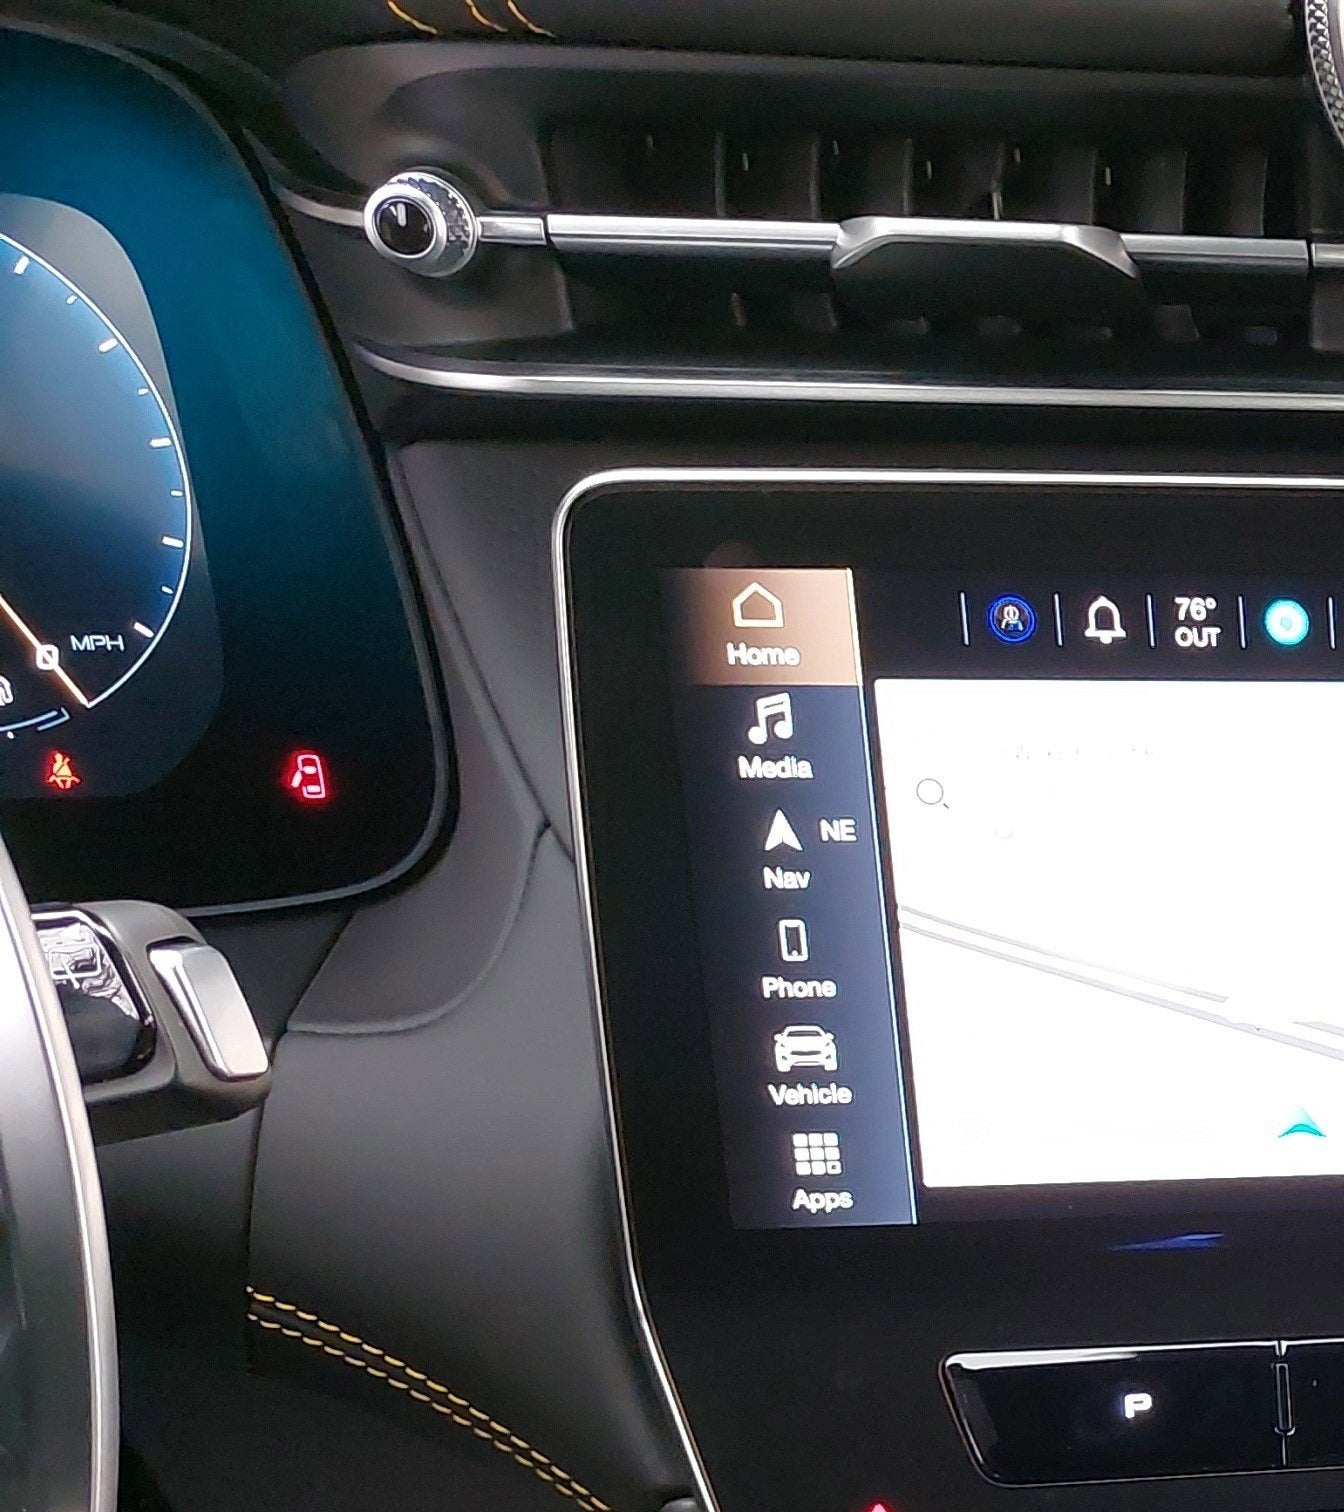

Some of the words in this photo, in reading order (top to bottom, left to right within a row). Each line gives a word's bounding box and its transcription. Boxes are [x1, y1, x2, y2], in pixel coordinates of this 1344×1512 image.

[70, 634, 125, 652] MPH
[1175, 626, 1222, 649] OUT
[727, 643, 802, 667] Home
[738, 756, 814, 780] Media
[820, 819, 858, 842] NE
[763, 867, 811, 890] Nav
[761, 977, 837, 1000] Phone
[768, 1083, 853, 1107] Vehicle
[791, 1189, 854, 1214] Apps
[1124, 1392, 1154, 1419] P
